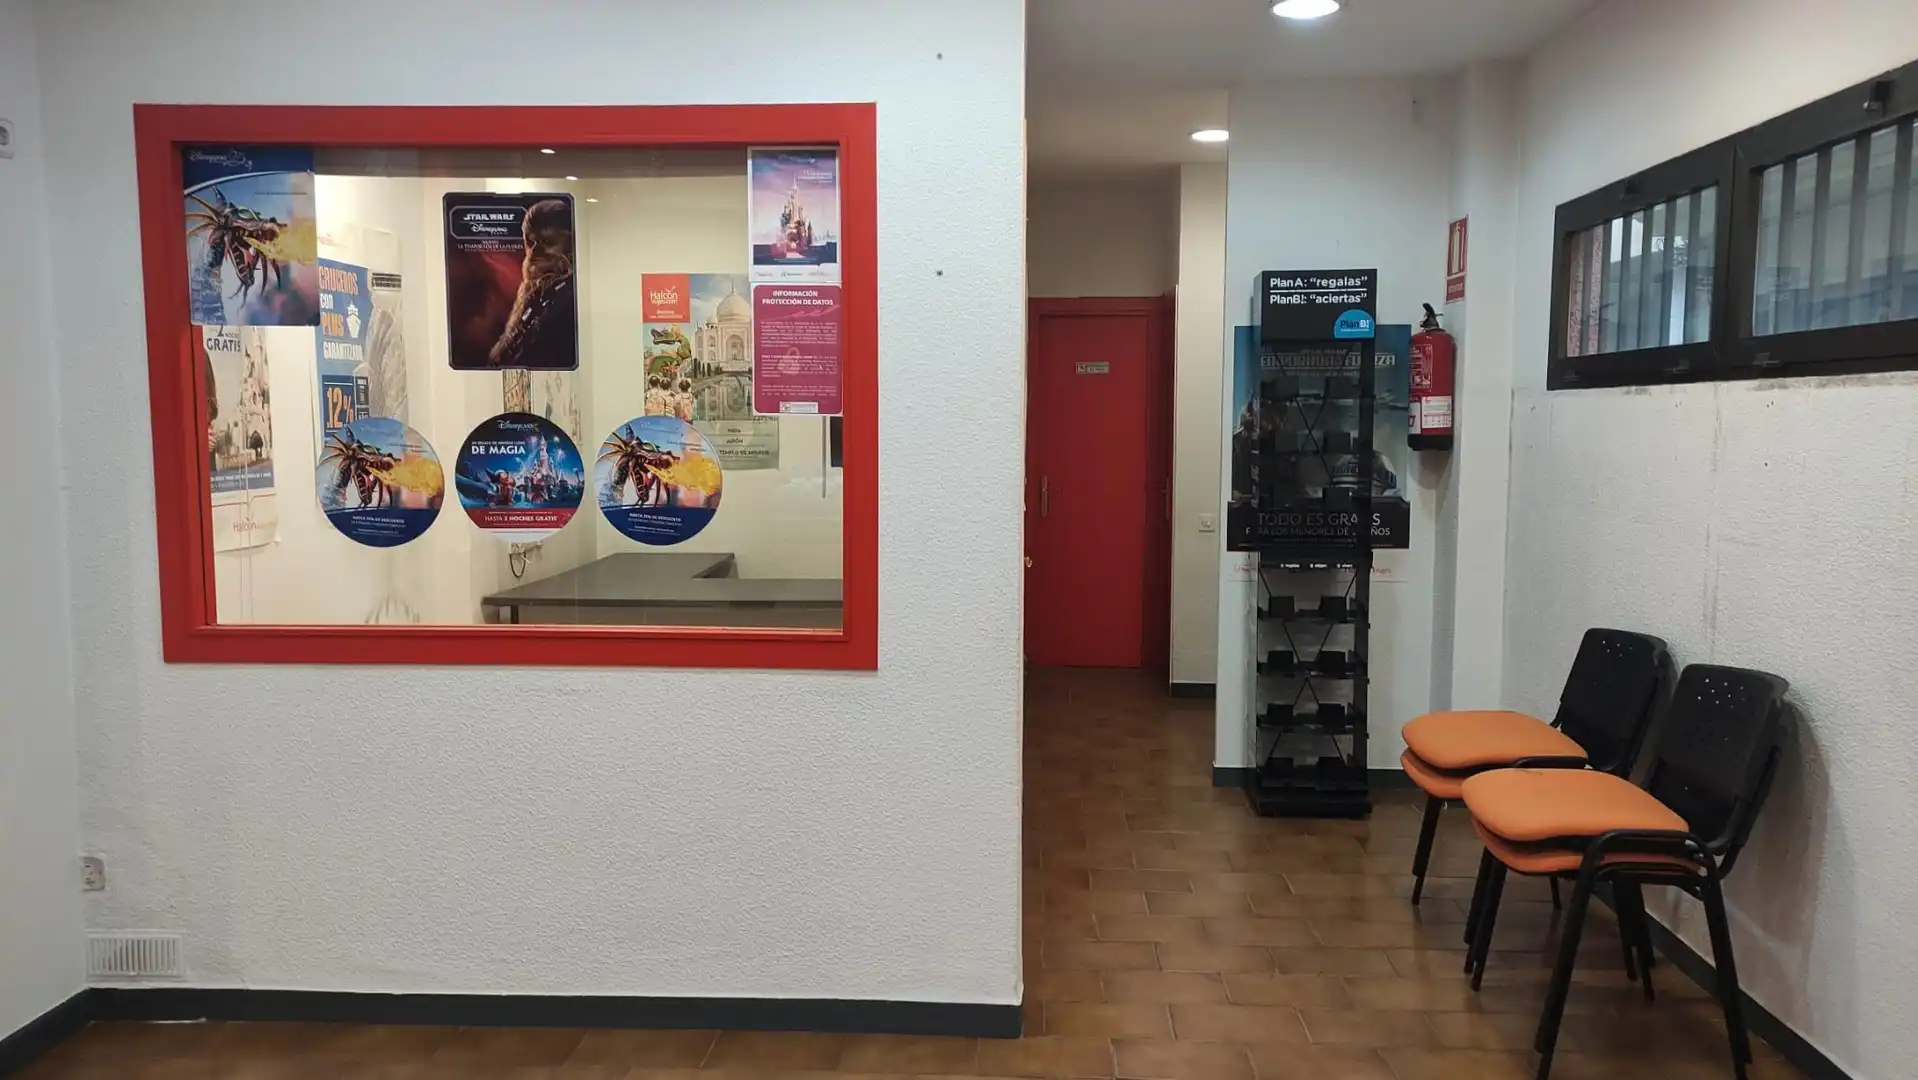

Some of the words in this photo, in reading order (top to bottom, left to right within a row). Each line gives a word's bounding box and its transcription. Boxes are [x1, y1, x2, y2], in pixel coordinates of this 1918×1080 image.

[463, 213, 489, 221] STAR
[490, 213, 515, 221] WARS
[319, 266, 359, 296] CRUCEROS
[650, 287, 678, 300] Halcón
[772, 289, 818, 297] INFORMACIÓN
[320, 312, 345, 337] PLUS
[1340, 319, 1370, 329] PlanB!
[326, 387, 354, 429] 12%
[471, 445, 485, 455] DE
[489, 445, 526, 455] MAGIA
[1306, 513, 1324, 526] ES
[1328, 513, 1381, 526] GRAS
